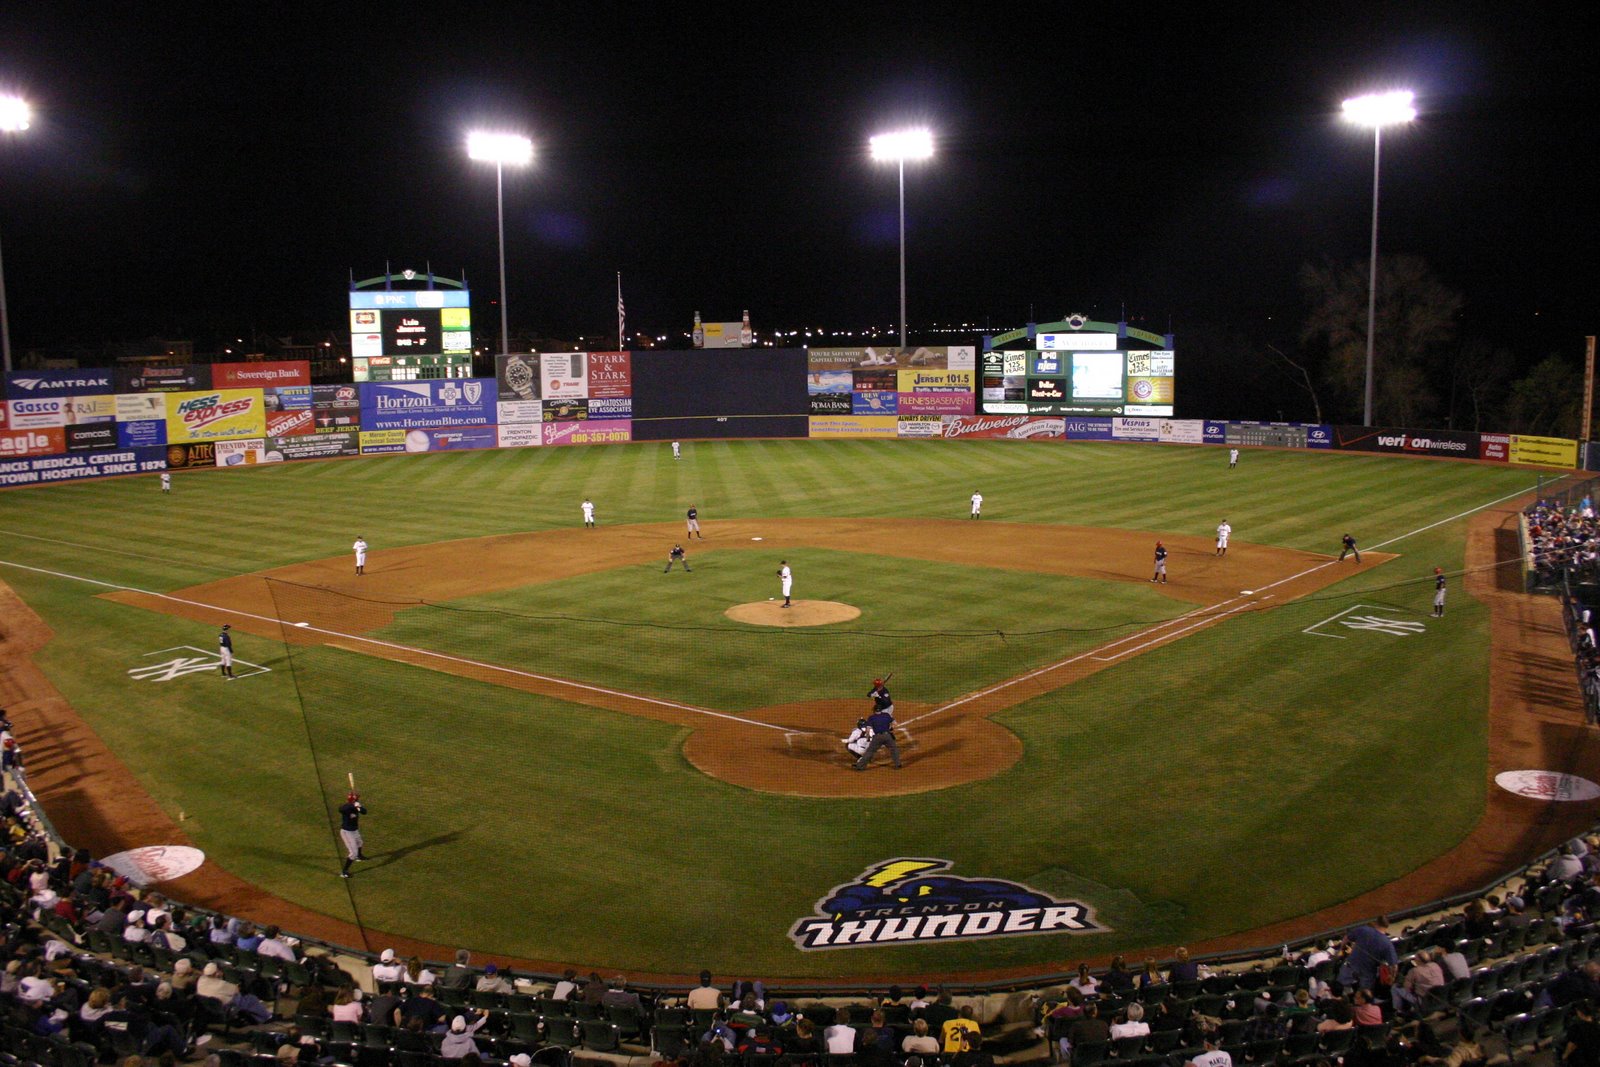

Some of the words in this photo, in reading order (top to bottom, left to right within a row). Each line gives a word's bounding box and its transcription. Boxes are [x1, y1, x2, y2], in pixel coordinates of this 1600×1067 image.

[385, 295, 406, 304] PNC
[591, 354, 626, 364] STARK
[604, 363, 613, 372] &
[237, 370, 277, 381] Sovereign
[278, 369, 300, 378] Bank
[591, 370, 626, 380] STARK
[946, 373, 970, 383] 101.5
[38, 378, 108, 389] AMTRAK
[13, 401, 60, 413] Gasco
[177, 394, 220, 414] HESS
[375, 394, 432, 409] Horizon
[811, 401, 831, 409] ROMA
[831, 401, 850, 409] BANK
[266, 410, 313, 438] MODELL'S
[375, 416, 487, 429] www.HorizonBlue.com
[944, 415, 1029, 438] Budweiser
[1068, 422, 1085, 432] AIG
[73, 429, 111, 440] comcast
[0, 432, 49, 454] agle
[1488, 443, 1503, 451] Auto
[188, 444, 214, 459] AZTEC
[1485, 450, 1504, 458] Group
[0, 461, 30, 473] NCIS
[32, 456, 86, 470] MEDICAL
[88, 452, 136, 465] CENTER
[0, 471, 39, 485] TOWN
[41, 466, 101, 480] HOSPITAL
[103, 462, 137, 475] SINCE
[140, 460, 167, 471] 1874
[855, 901, 1004, 918] TRENTON
[802, 905, 1086, 947] THUNDER
